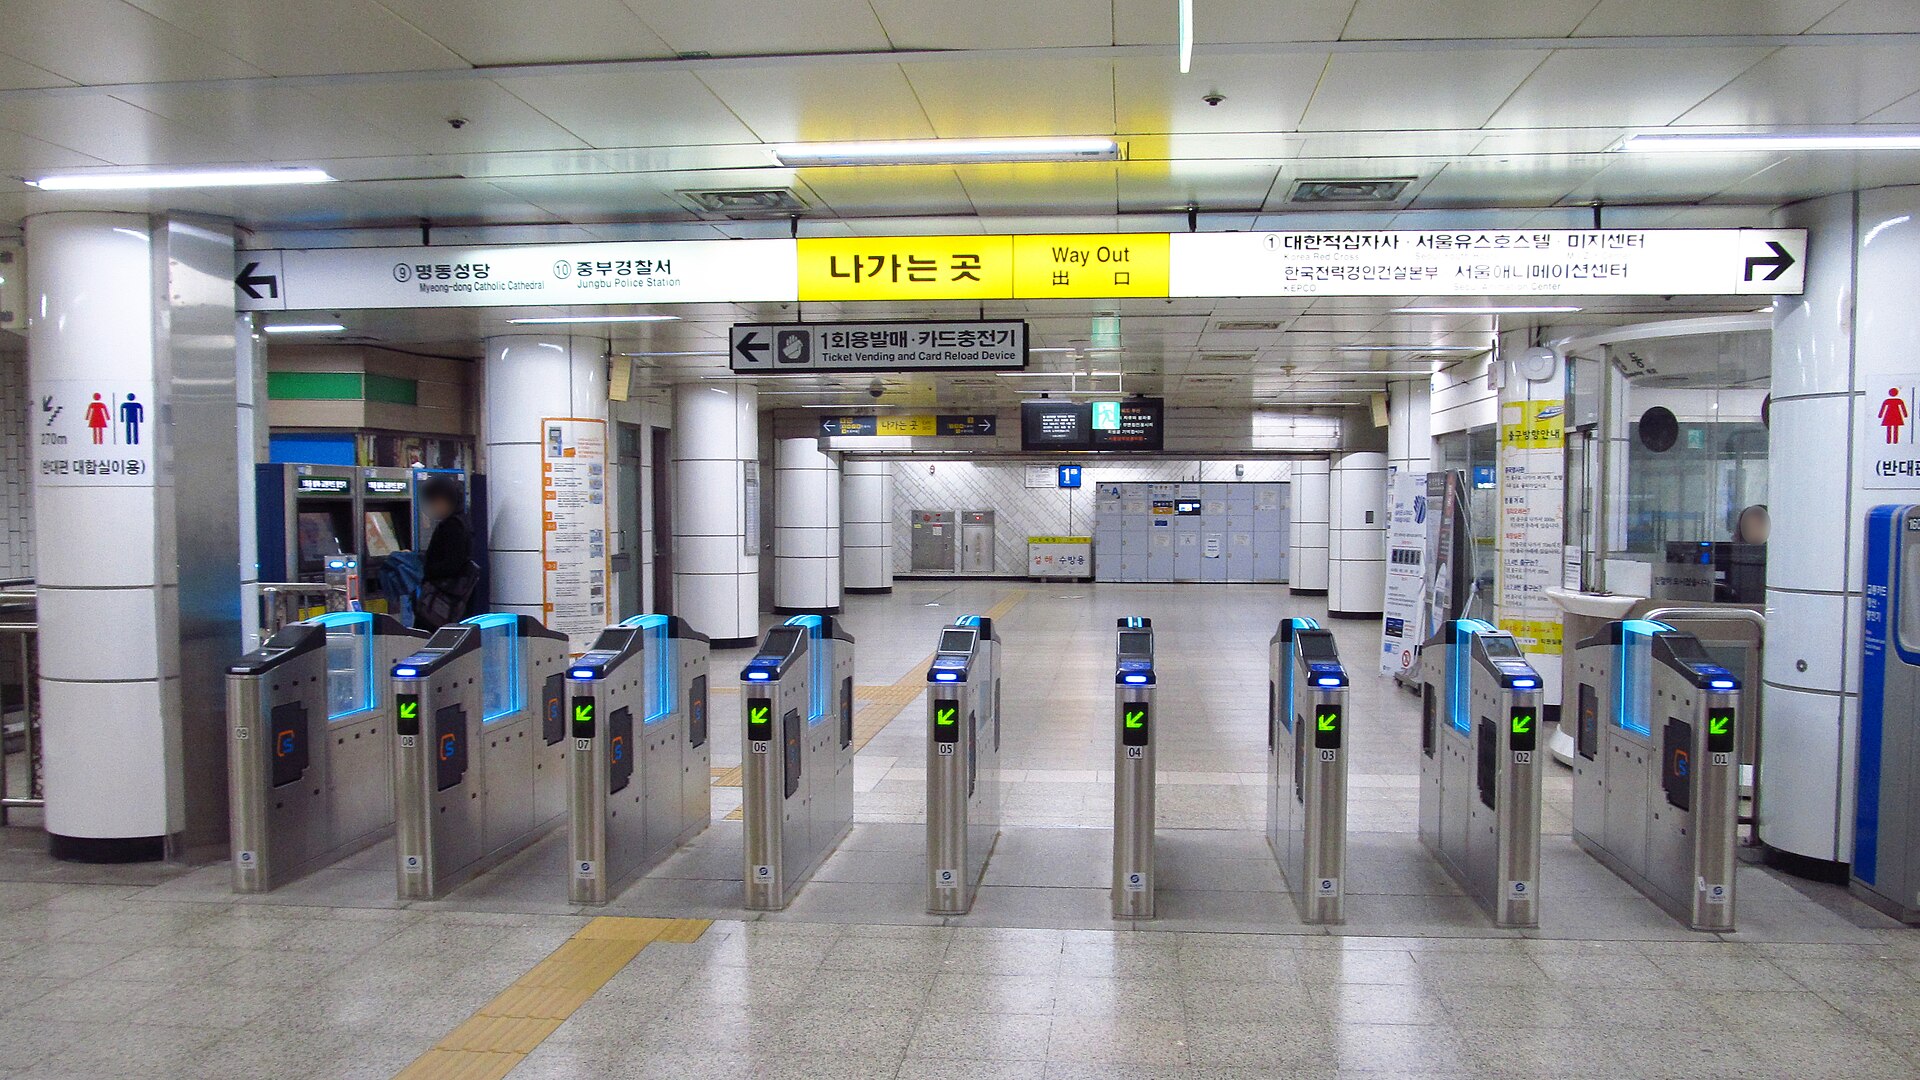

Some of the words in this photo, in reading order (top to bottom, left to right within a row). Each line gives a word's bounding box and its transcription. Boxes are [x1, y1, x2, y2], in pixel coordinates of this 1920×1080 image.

[1285, 234, 1400, 251] 대한적십자사
[1416, 233, 1551, 250] 서울유스호스텔
[1568, 233, 1645, 249] 미지센터
[1052, 247, 1090, 267] Way
[1097, 246, 1130, 262] Out
[416, 263, 490, 280] 명동성당
[576, 259, 672, 276] 중부경찰서
[830, 254, 937, 283] 나가는
[950, 254, 982, 282] 곳
[1285, 265, 1439, 281] 한국전력경인건설본부
[1454, 263, 1628, 280] 서울애니메이션센터
[419, 281, 472, 293] Myeong-dong
[473, 280, 505, 291] Catholic
[508, 279, 545, 290] Cathedral
[577, 279, 612, 289] Jungbu
[614, 278, 643, 288] Police
[646, 277, 681, 287] Station
[822, 352, 852, 362] Ticket
[855, 351, 895, 363] Vending
[898, 351, 916, 361] and
[919, 351, 942, 361] Card
[944, 350, 979, 361] Reload
[981, 349, 1016, 360] Device
[881, 420, 907, 431] 나가는
[909, 420, 918, 431] 곳
[41, 433, 68, 445] 270m
[1509, 429, 1560, 442] 출구방향안내
[73, 459, 146, 476] 대합실이용)
[1058, 555, 1085, 566] 수방용
[236, 728, 247, 738] 09
[402, 736, 414, 746] 08
[577, 739, 589, 749] 07
[754, 742, 766, 752] 06
[940, 744, 952, 754] 05
[1129, 747, 1140, 758] 04
[1322, 750, 1334, 760] 03
[1516, 752, 1529, 763] 02
[1714, 754, 1727, 764] 01
